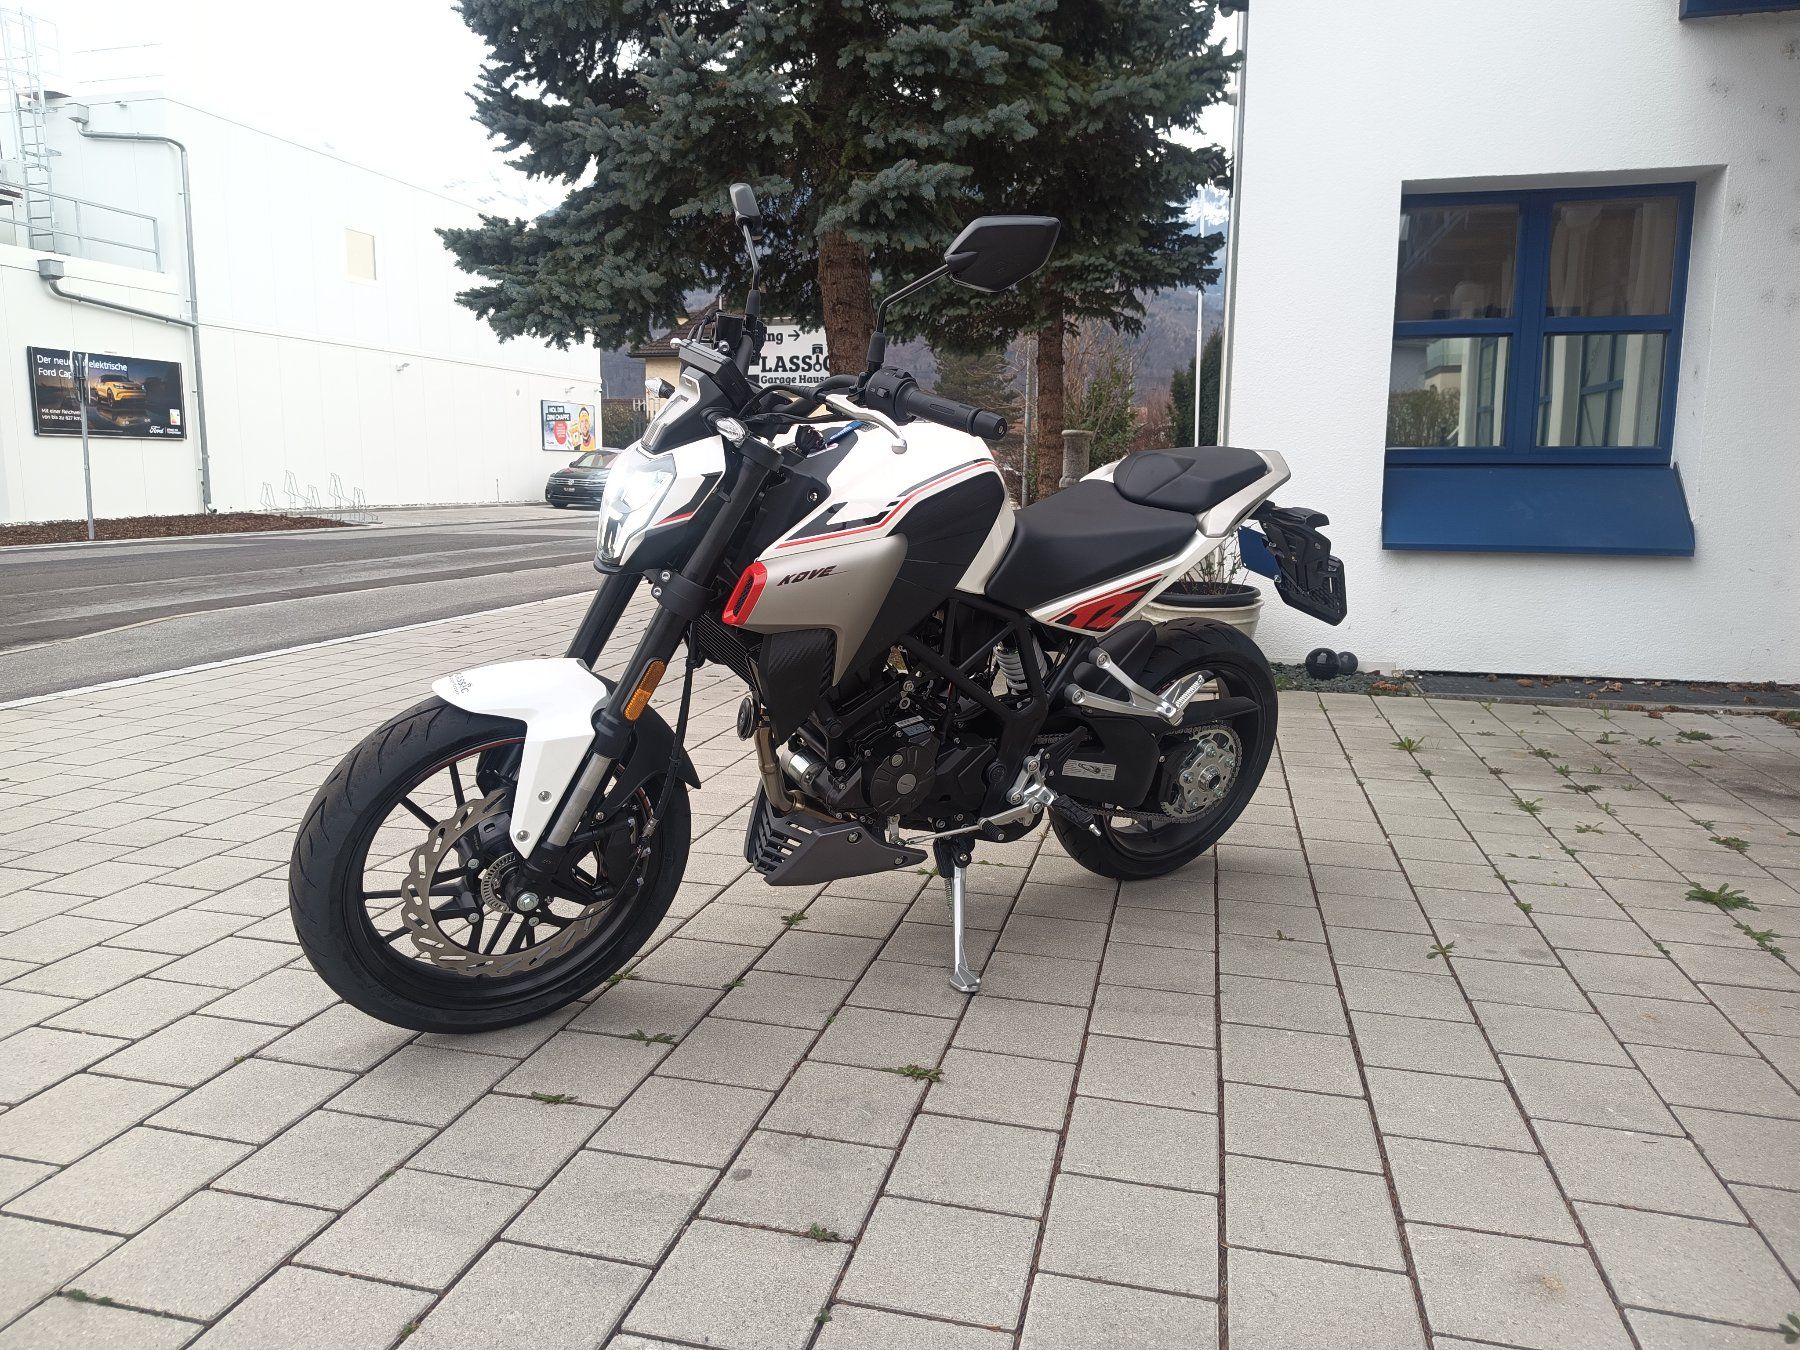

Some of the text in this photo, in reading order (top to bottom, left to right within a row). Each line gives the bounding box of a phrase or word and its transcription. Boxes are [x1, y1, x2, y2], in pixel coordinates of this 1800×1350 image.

[767, 332, 784, 345] ng
[37, 355, 51, 364] Der
[38, 367, 73, 379] Ford Cap
[760, 375, 797, 385] Garage
[776, 564, 838, 587] KOVE
